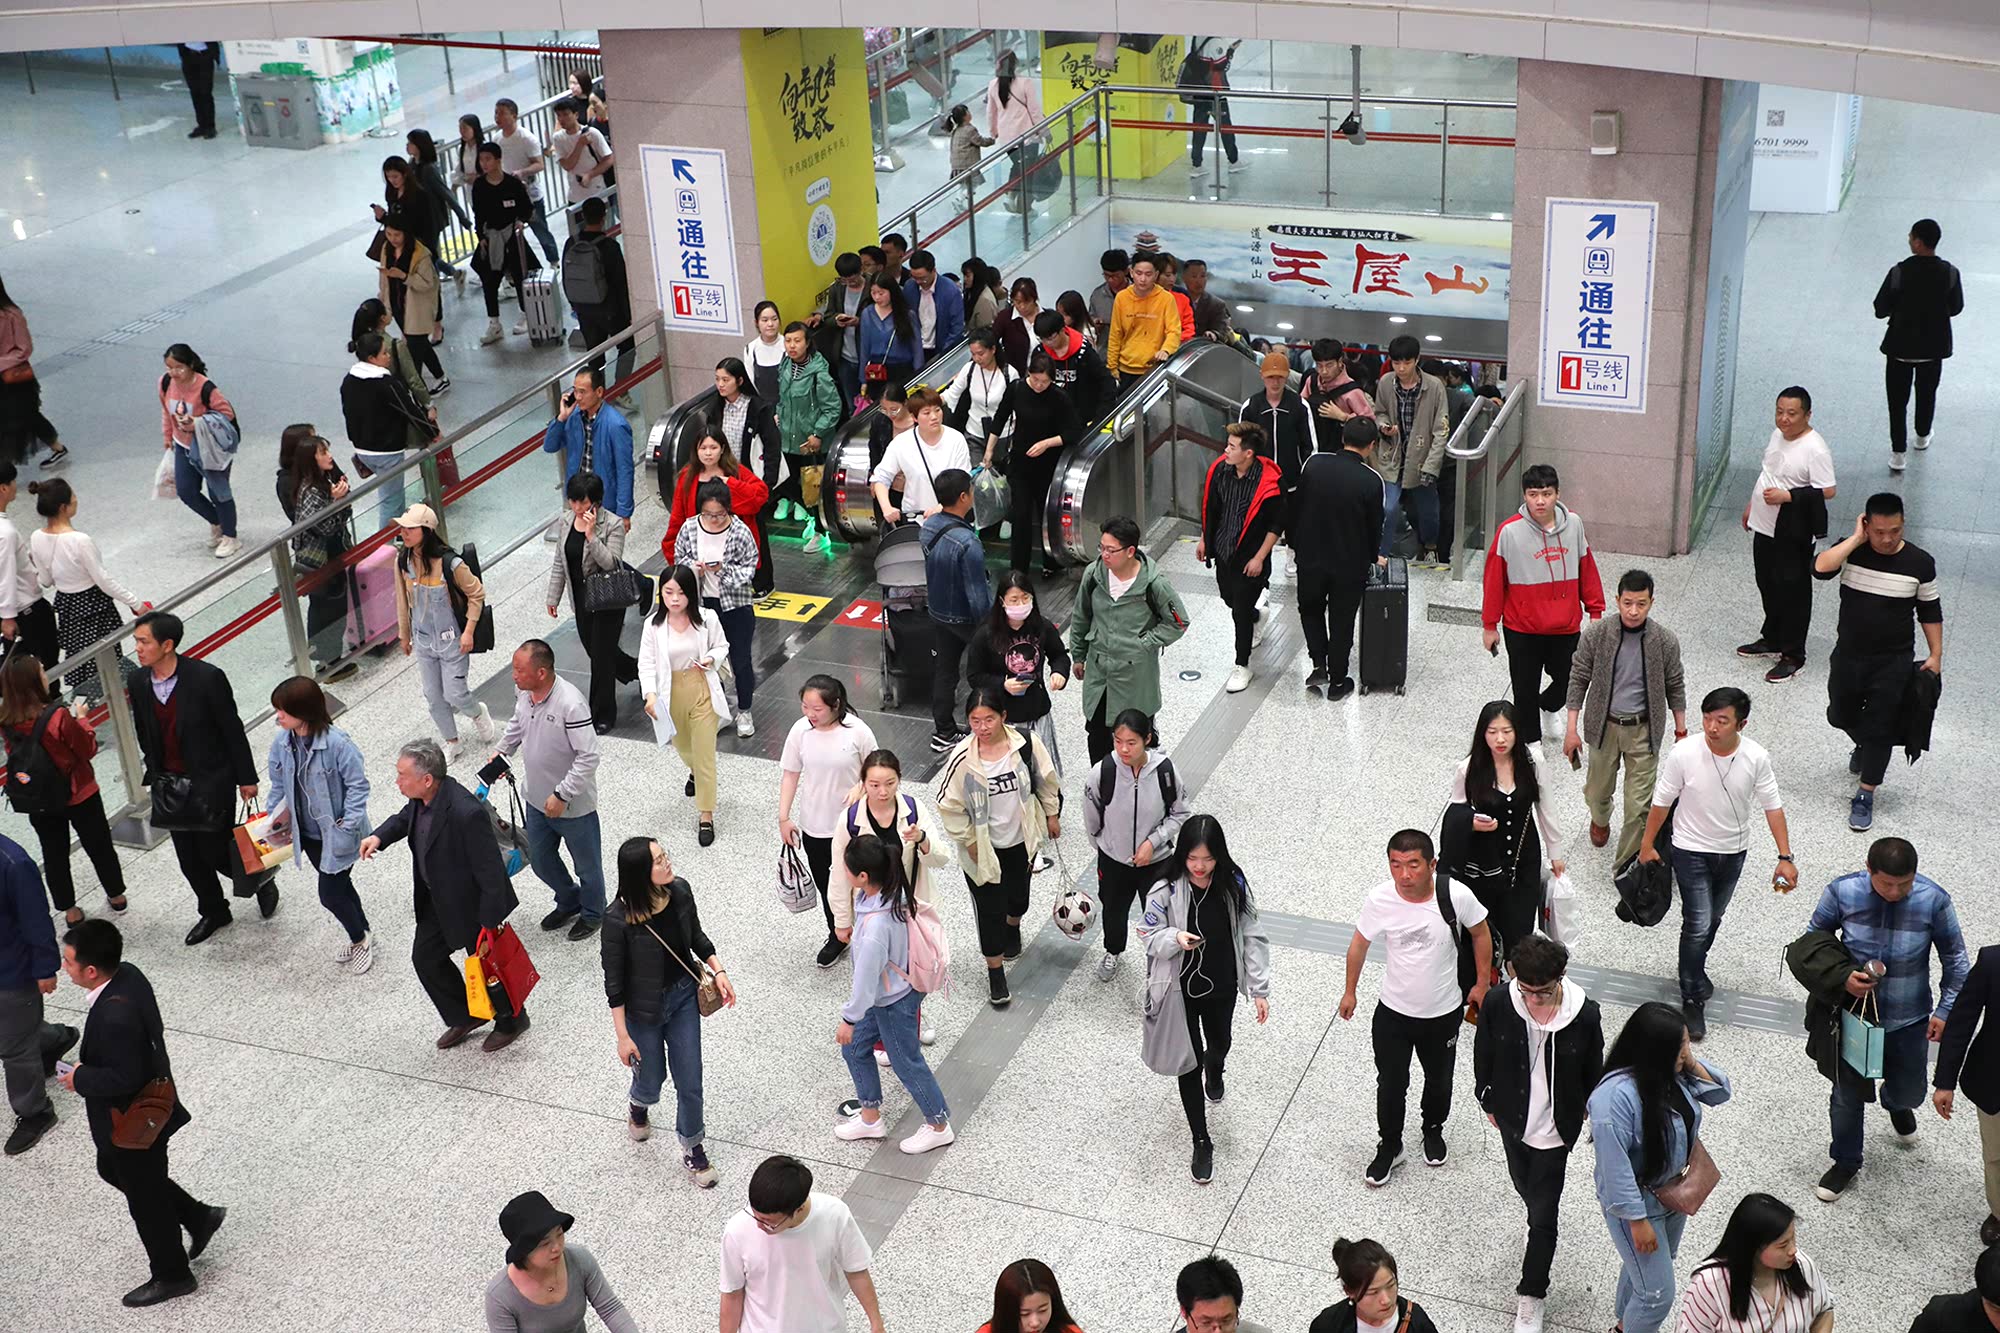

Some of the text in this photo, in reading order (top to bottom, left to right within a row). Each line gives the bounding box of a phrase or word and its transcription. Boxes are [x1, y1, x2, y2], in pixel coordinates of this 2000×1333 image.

[1783, 138, 1808, 146] 9999
[677, 218, 710, 279] 通往
[1250, 227, 1263, 280] 道源仙山
[1268, 242, 1489, 298] 王屋山
[695, 308, 712, 317] Line
[1577, 280, 1614, 349] 通往
[1587, 381, 1608, 392] Line
